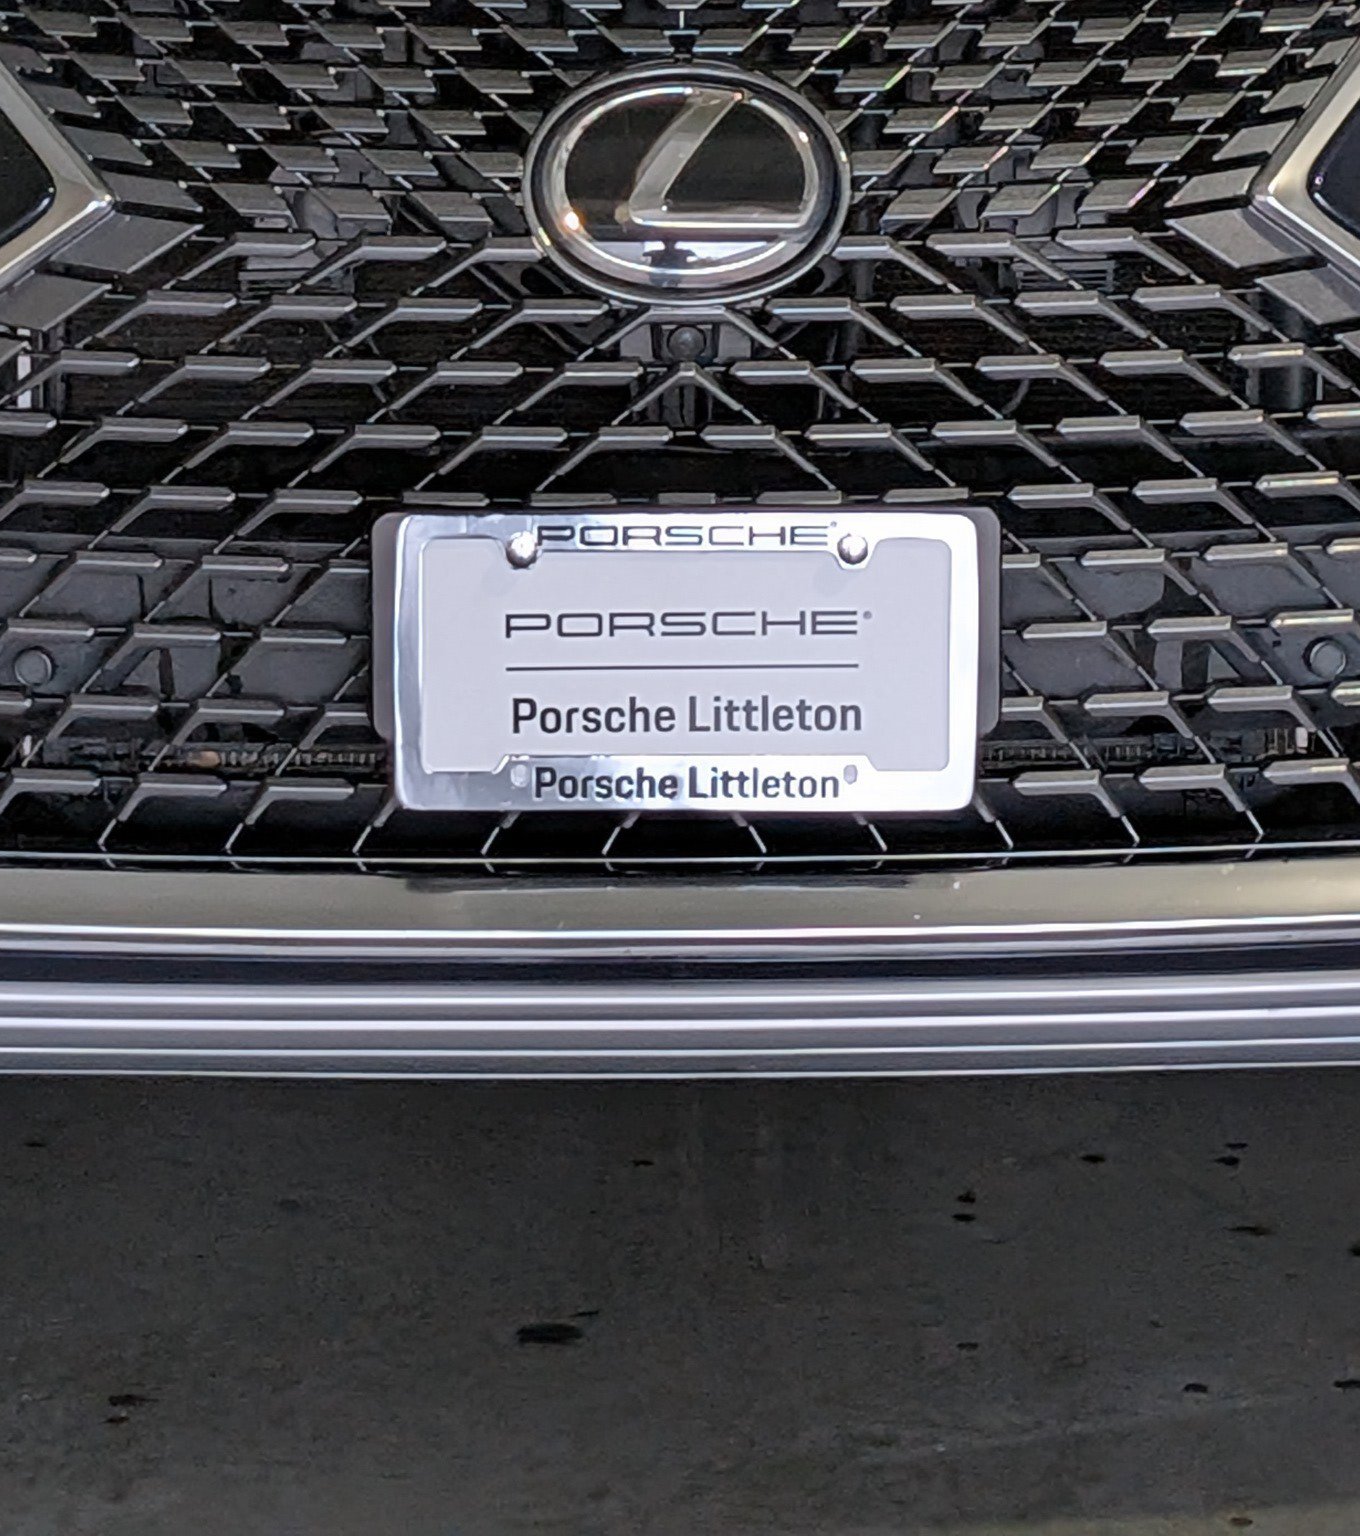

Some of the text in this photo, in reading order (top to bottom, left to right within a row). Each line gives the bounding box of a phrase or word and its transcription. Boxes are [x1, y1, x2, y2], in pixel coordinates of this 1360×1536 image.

[537, 525, 828, 546] PORSCHE
[505, 610, 858, 637] PORSCHE
[511, 695, 863, 734] Porsche Littleton
[534, 766, 839, 799] Porsche Littleton
